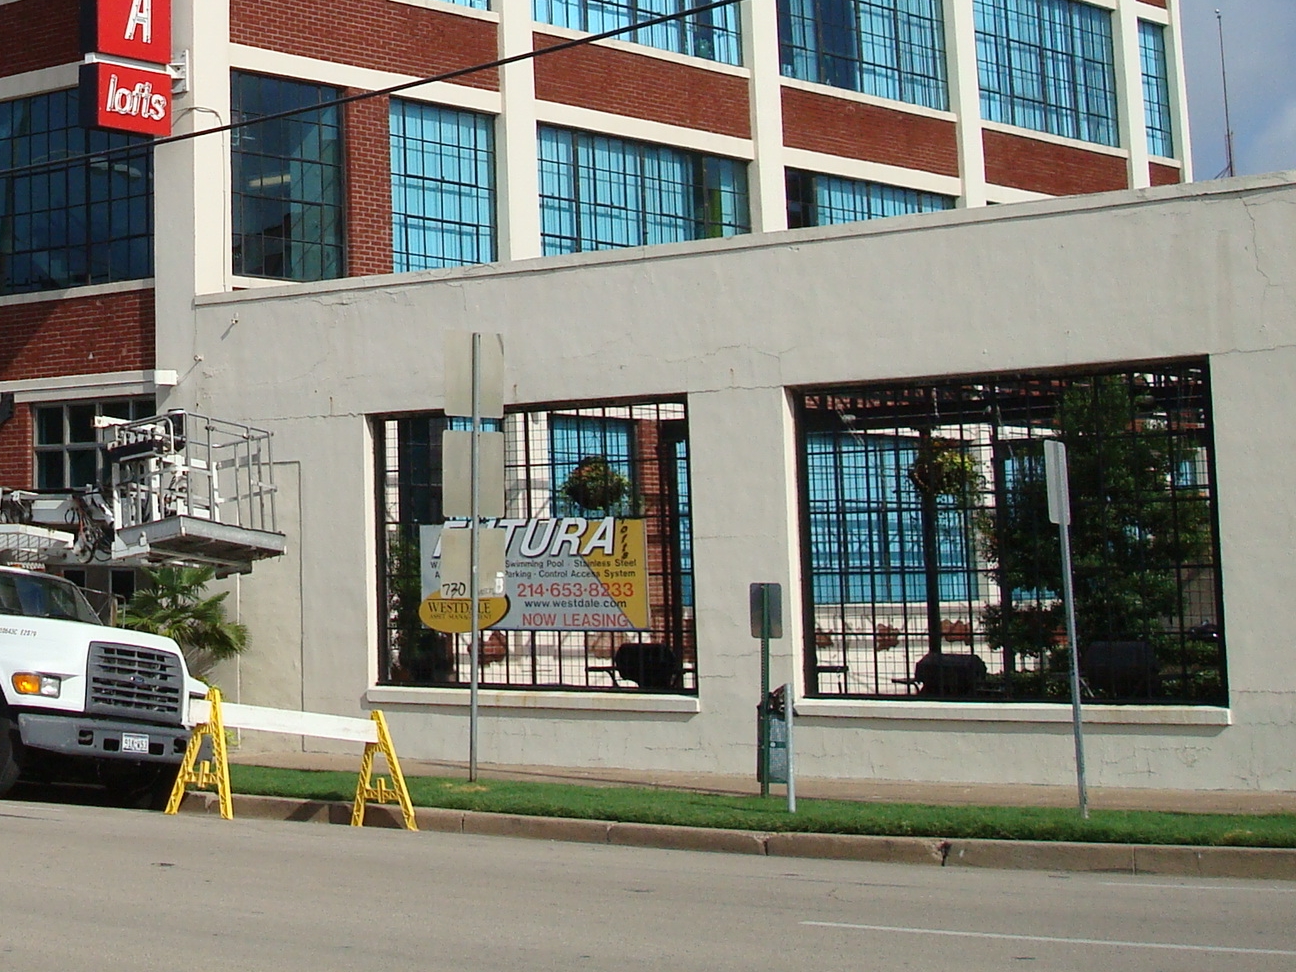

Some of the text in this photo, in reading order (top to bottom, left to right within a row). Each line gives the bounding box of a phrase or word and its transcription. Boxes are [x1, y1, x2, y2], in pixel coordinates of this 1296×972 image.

[106, 74, 167, 120] lofts
[505, 558, 637, 569] Swimming Pool Stainless Steel
[538, 569, 568, 578] Control
[570, 570, 600, 579] Access
[603, 569, 636, 579] System
[427, 601, 491, 614] WESTDLE
[523, 599, 628, 609] www.westdale.com
[522, 613, 629, 628] NOW LEASING
